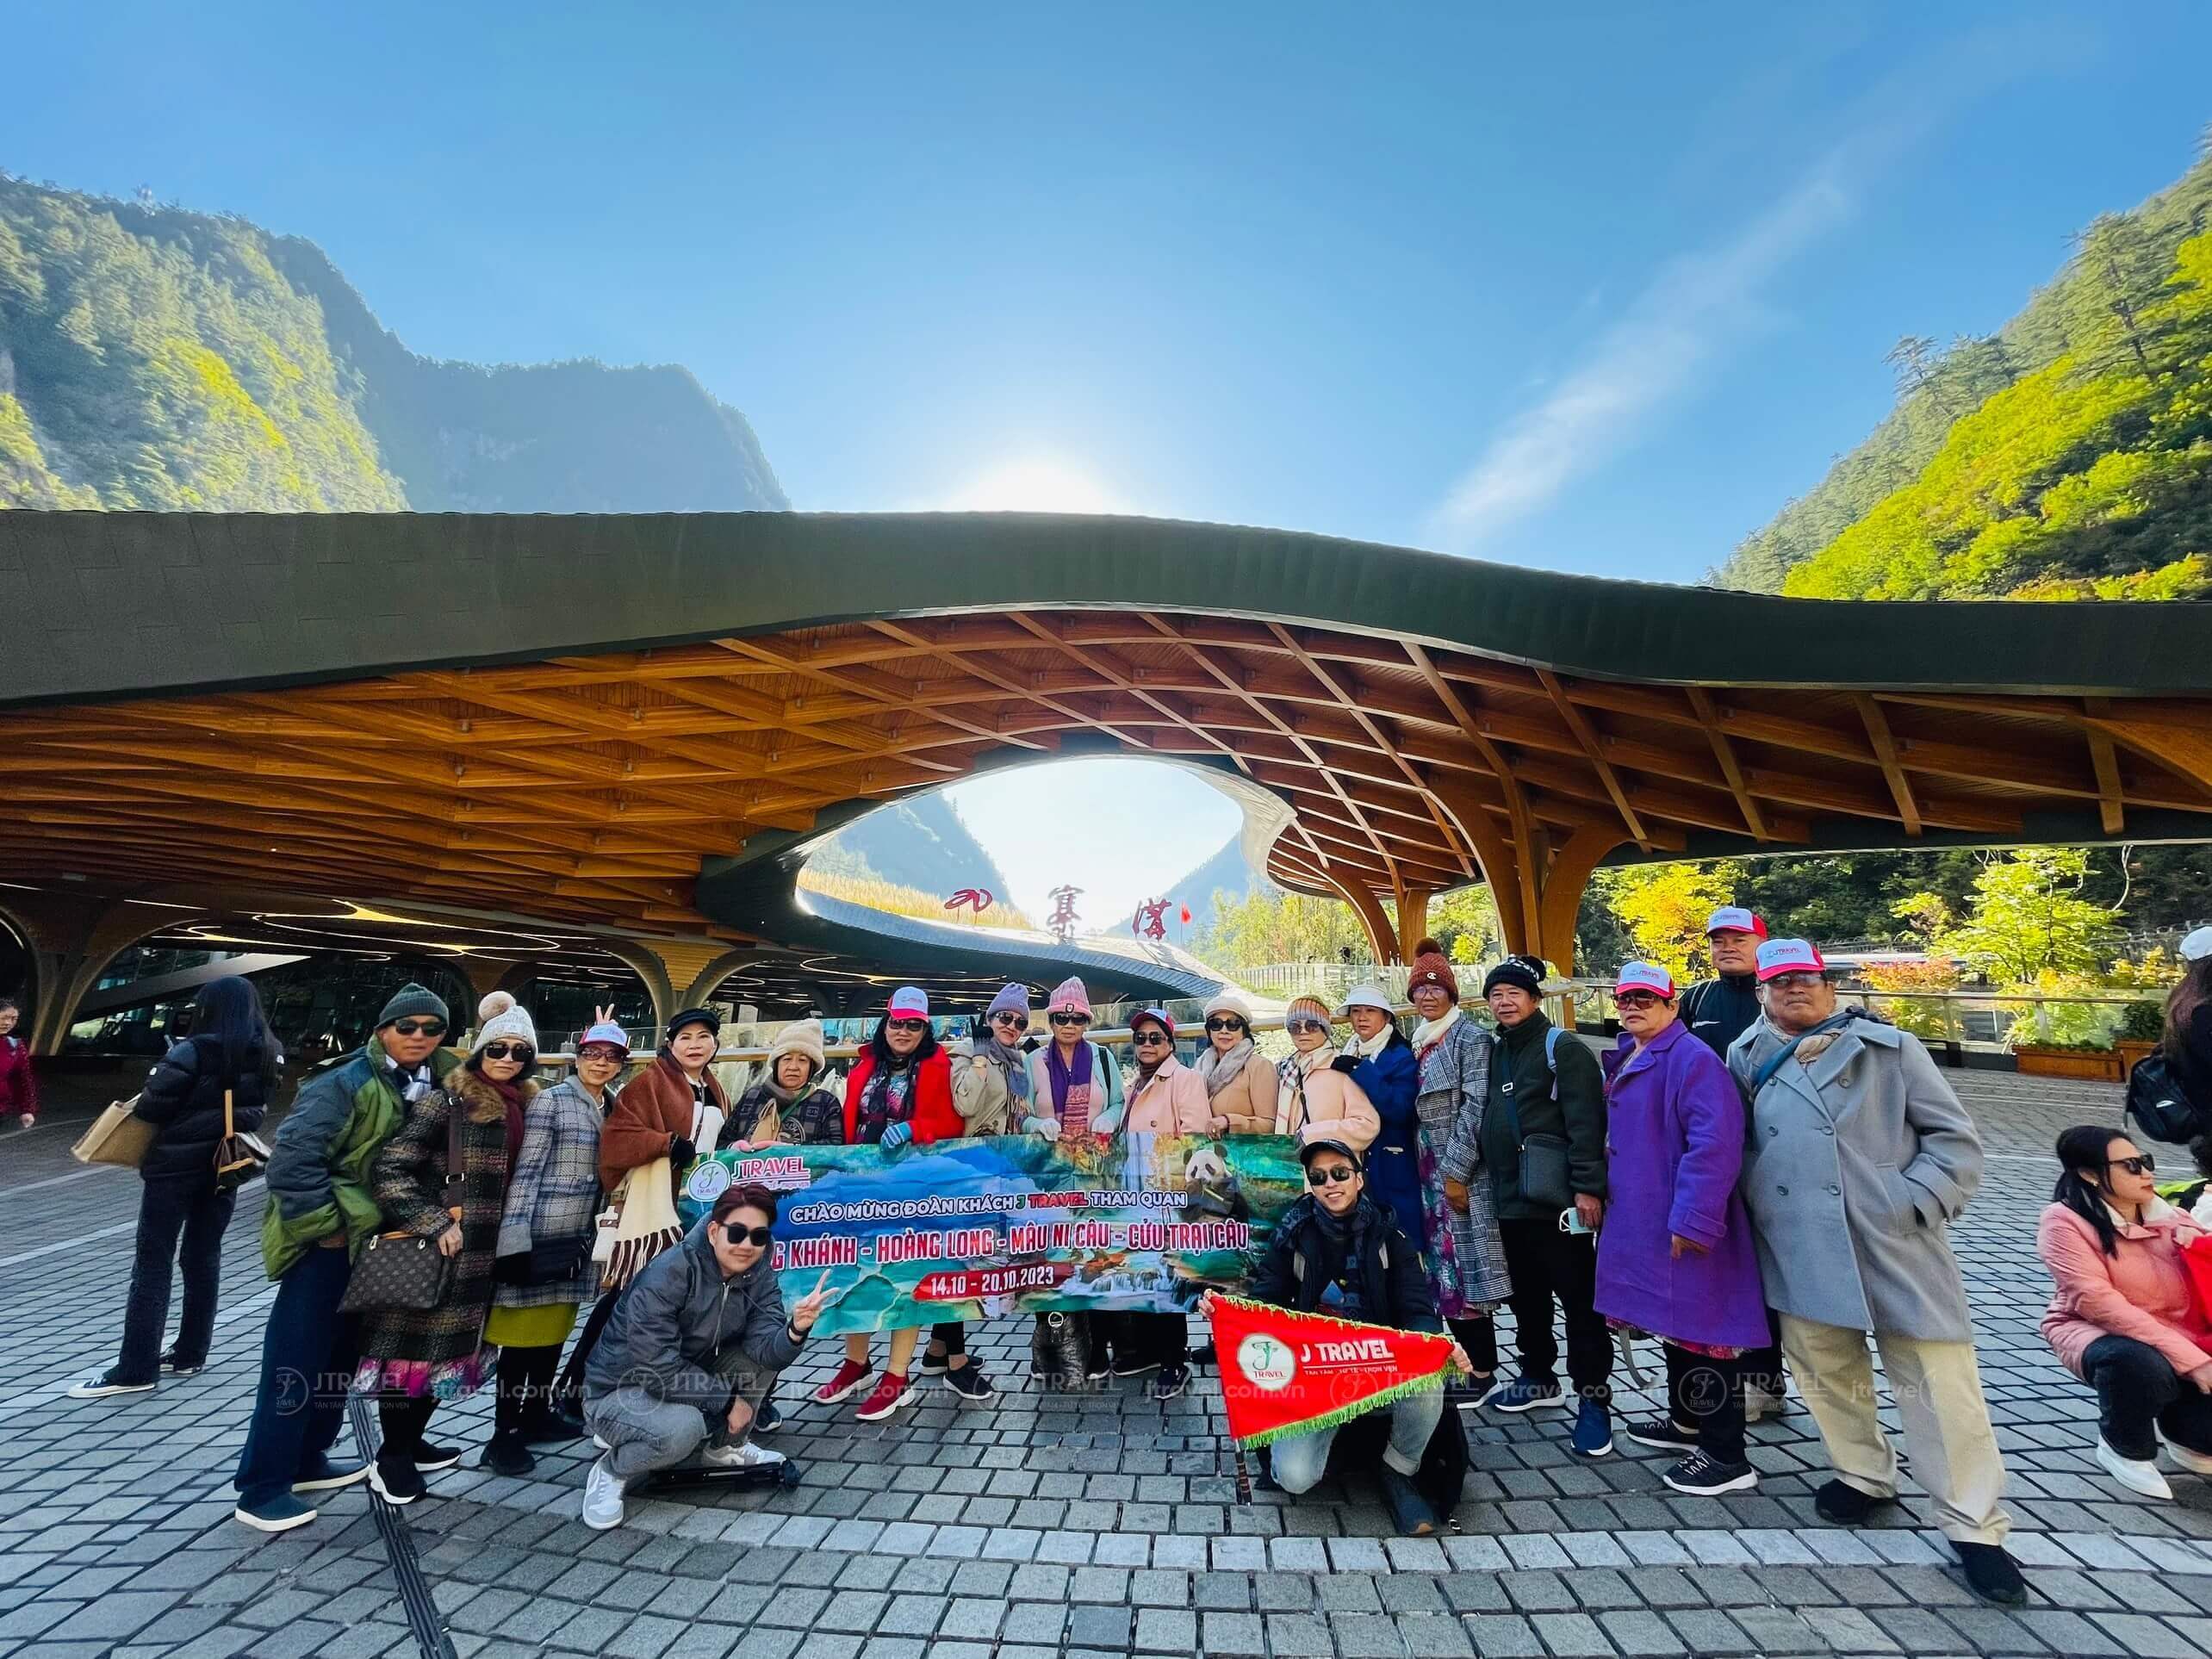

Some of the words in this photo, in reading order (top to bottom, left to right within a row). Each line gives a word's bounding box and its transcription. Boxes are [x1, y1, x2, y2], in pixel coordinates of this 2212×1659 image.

[790, 1202, 843, 1223] CHÀO
[845, 1199, 901, 1221] MỪNG
[903, 1196, 955, 1219] ĐOÀN
[957, 1194, 1014, 1215] KHÁCH
[1028, 1191, 1090, 1209] TRAVEL
[1090, 1190, 1137, 1208] THAM
[1140, 1190, 1188, 1209] QUAN
[790, 1233, 857, 1269] KHÁNH
[876, 1227, 941, 1264] HOÀNG
[947, 1227, 994, 1260] LONG
[1010, 1220, 1049, 1254] MÂU
[1053, 1222, 1072, 1248] NI
[1074, 1217, 1110, 1249] CÂU
[1128, 1218, 1165, 1251] CỬU
[1168, 1221, 1210, 1257] TRẠI
[1212, 1218, 1249, 1250] CÂU
[930, 1275, 966, 1296] 14.10
[981, 1265, 1055, 1293] 20.10.2023
[1300, 1343, 1311, 1363] J
[1314, 1339, 1395, 1362] TRAVEL
[1253, 1370, 1288, 1379] TRAVEL
